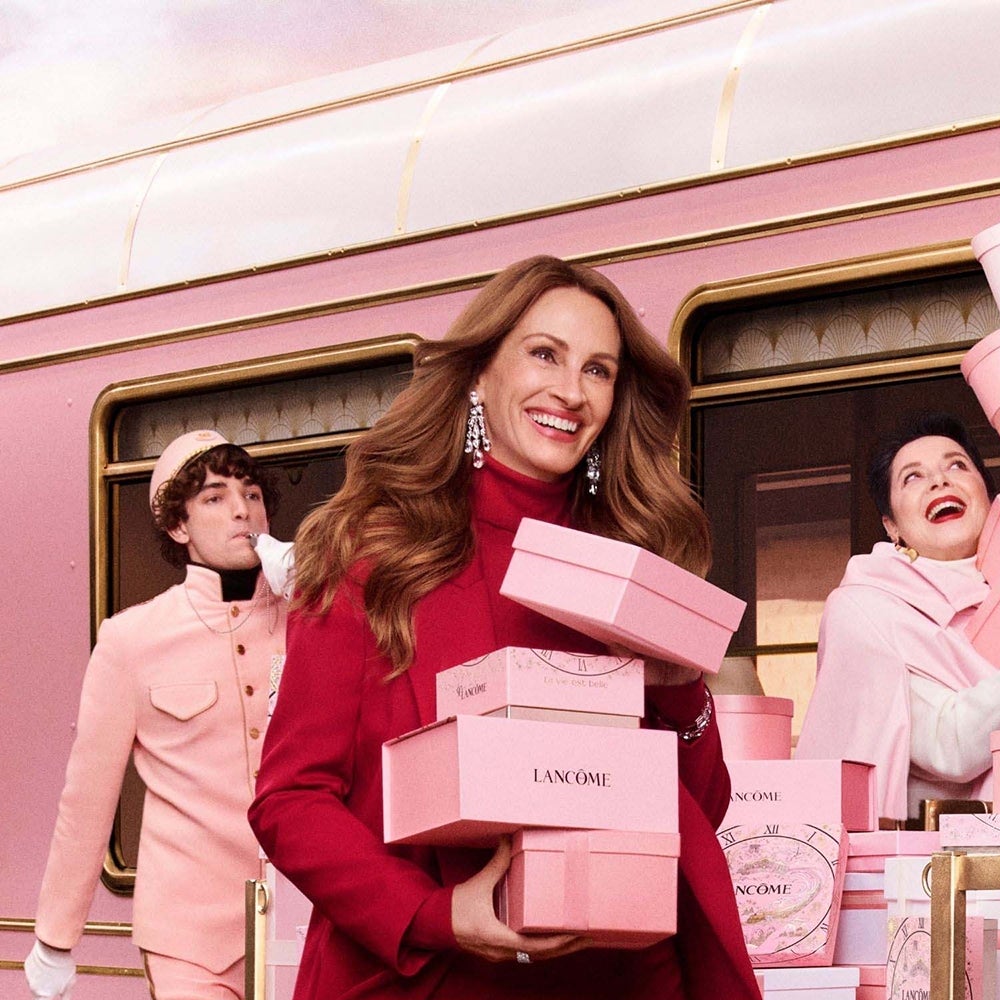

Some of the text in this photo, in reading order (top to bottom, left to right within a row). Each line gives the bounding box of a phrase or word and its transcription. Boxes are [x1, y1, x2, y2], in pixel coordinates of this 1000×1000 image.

[533, 768, 611, 788] LANCÔME
[731, 790, 782, 802] NCÔME
[735, 882, 792, 895] NCÔME
